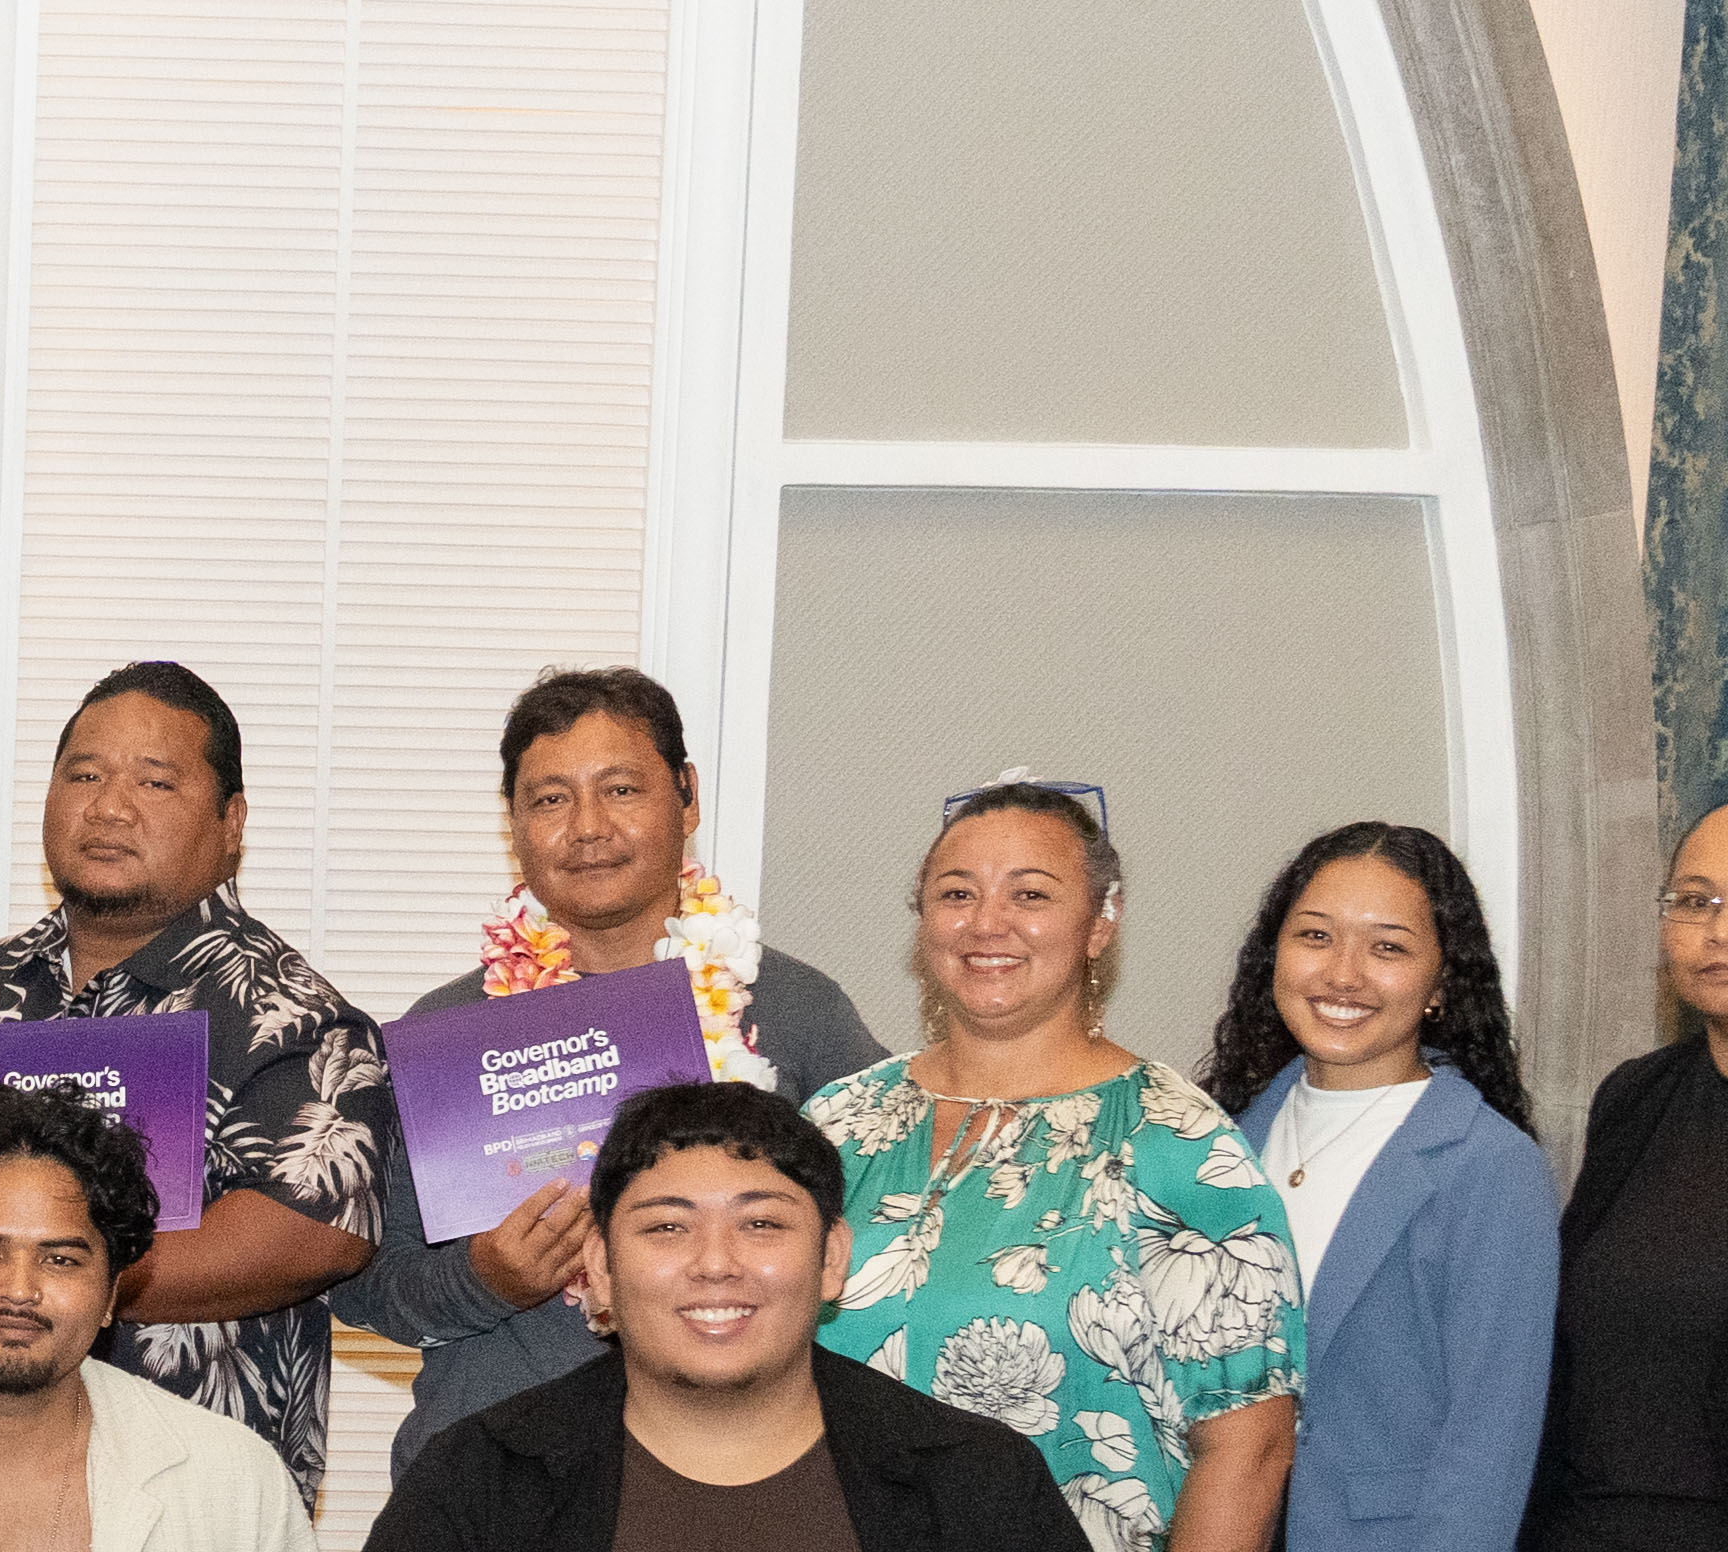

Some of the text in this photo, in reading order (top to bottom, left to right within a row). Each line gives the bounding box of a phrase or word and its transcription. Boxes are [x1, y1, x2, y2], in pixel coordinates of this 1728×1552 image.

[481, 1027, 609, 1072] Governor's
[492, 1072, 617, 1116] Bootcamp
[483, 1140, 512, 1156] BPD
